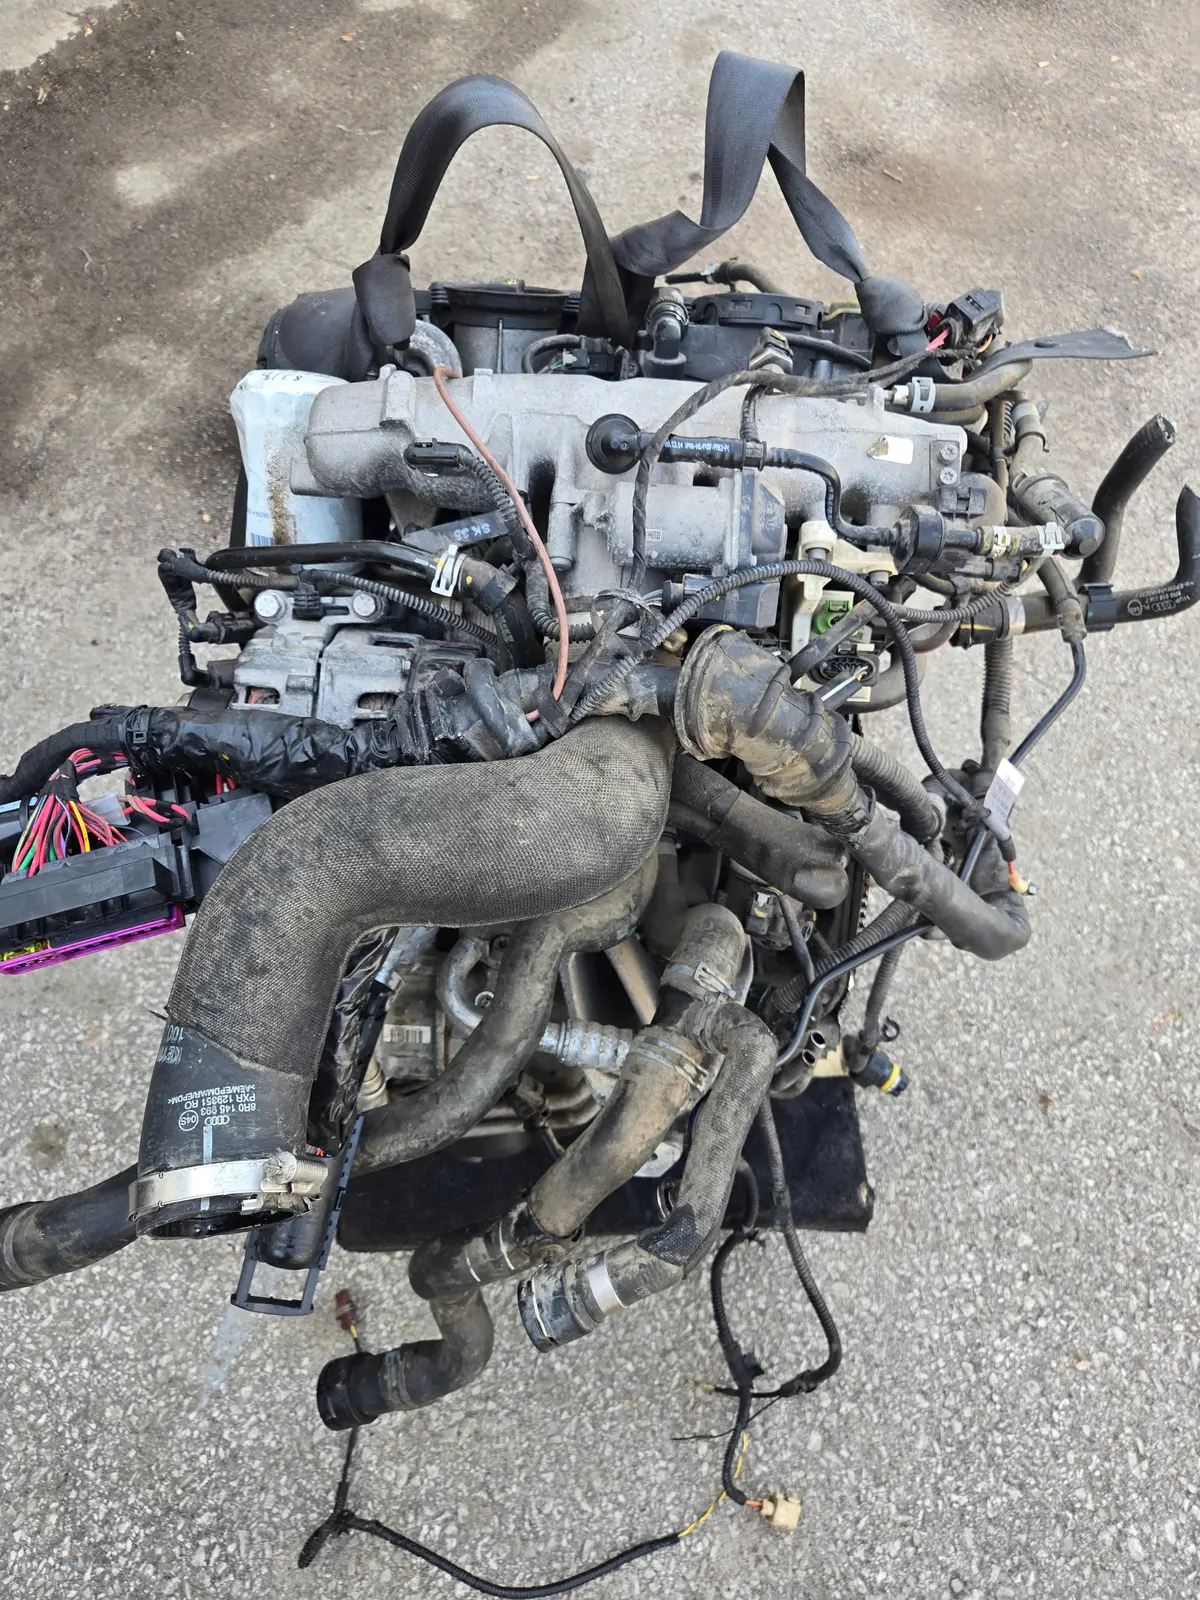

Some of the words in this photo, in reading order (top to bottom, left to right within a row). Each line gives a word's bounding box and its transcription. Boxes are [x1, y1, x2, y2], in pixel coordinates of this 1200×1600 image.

[202, 1094, 234, 1106] 129351
[236, 1092, 256, 1102] PXR
[219, 1103, 236, 1114] 145
[238, 1102, 256, 1112] 8R0
[180, 1115, 197, 1126] 04S
